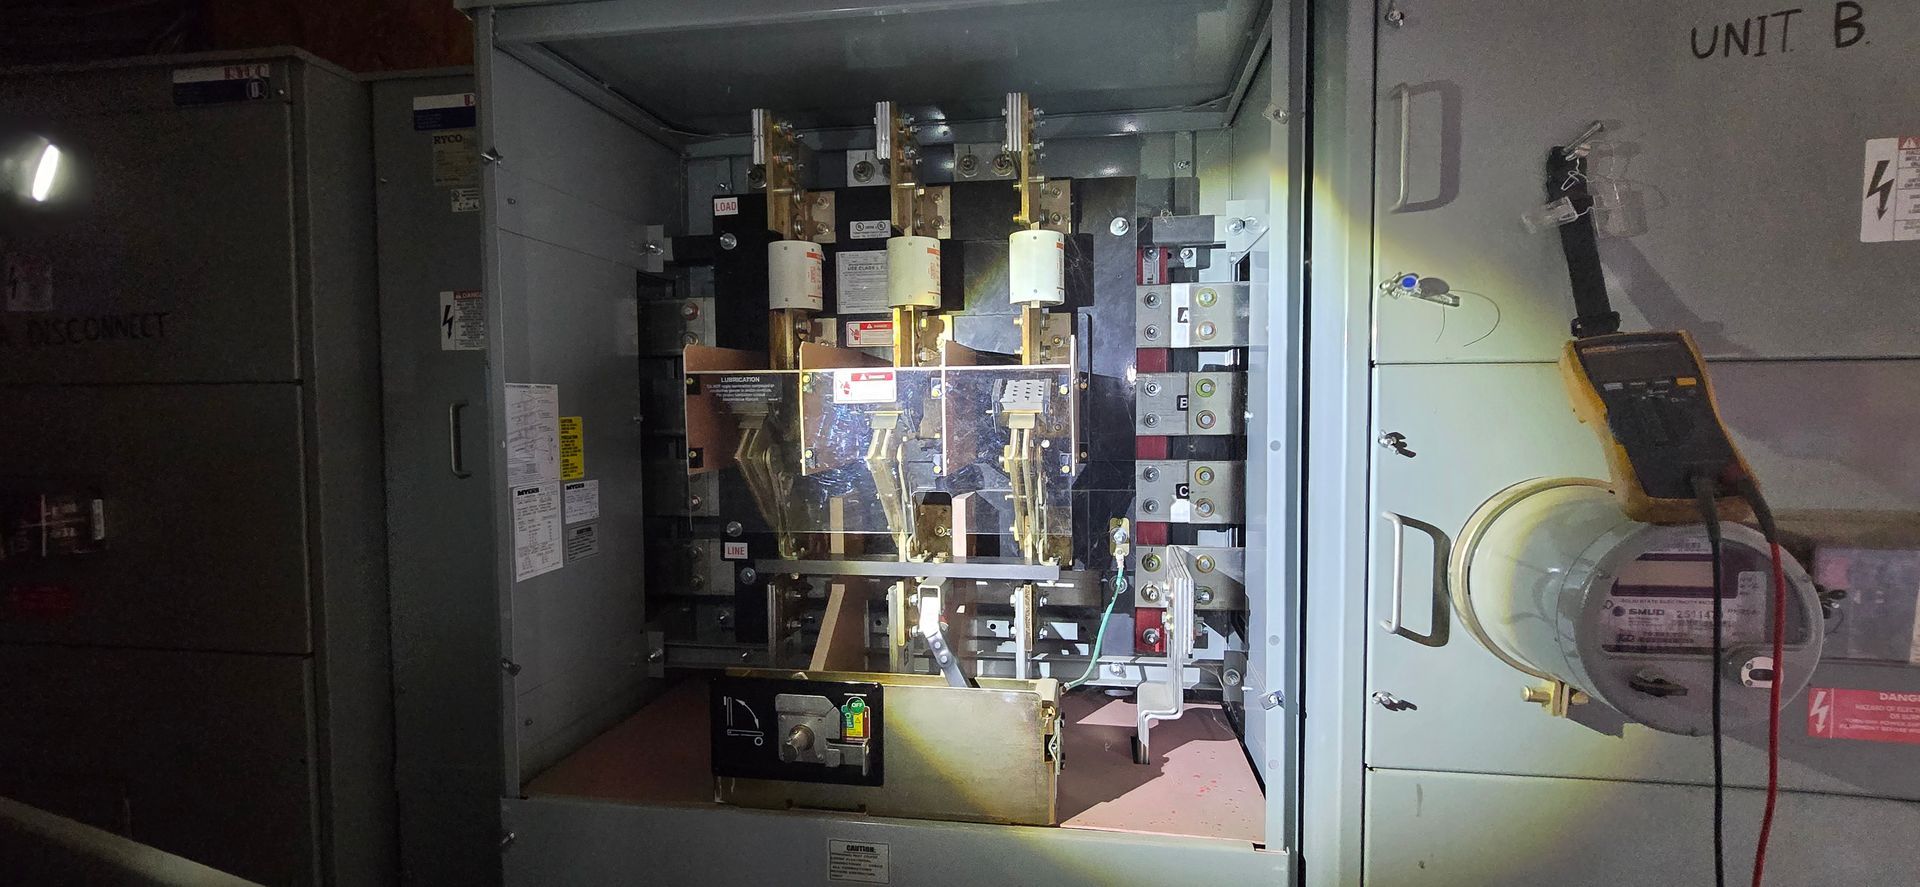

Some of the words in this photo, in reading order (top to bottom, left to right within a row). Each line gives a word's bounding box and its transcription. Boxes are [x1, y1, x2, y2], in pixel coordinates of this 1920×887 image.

[434, 134, 464, 145] RYCO
[715, 201, 737, 212] LOAD
[1180, 310, 1189, 321] A
[27, 312, 170, 345] DISCONNECT
[1180, 397, 1189, 408] B
[1179, 485, 1189, 497] C
[727, 546, 745, 555] LINE
[1628, 608, 1665, 616] SMUD
[1880, 692, 1920, 703] DANG
